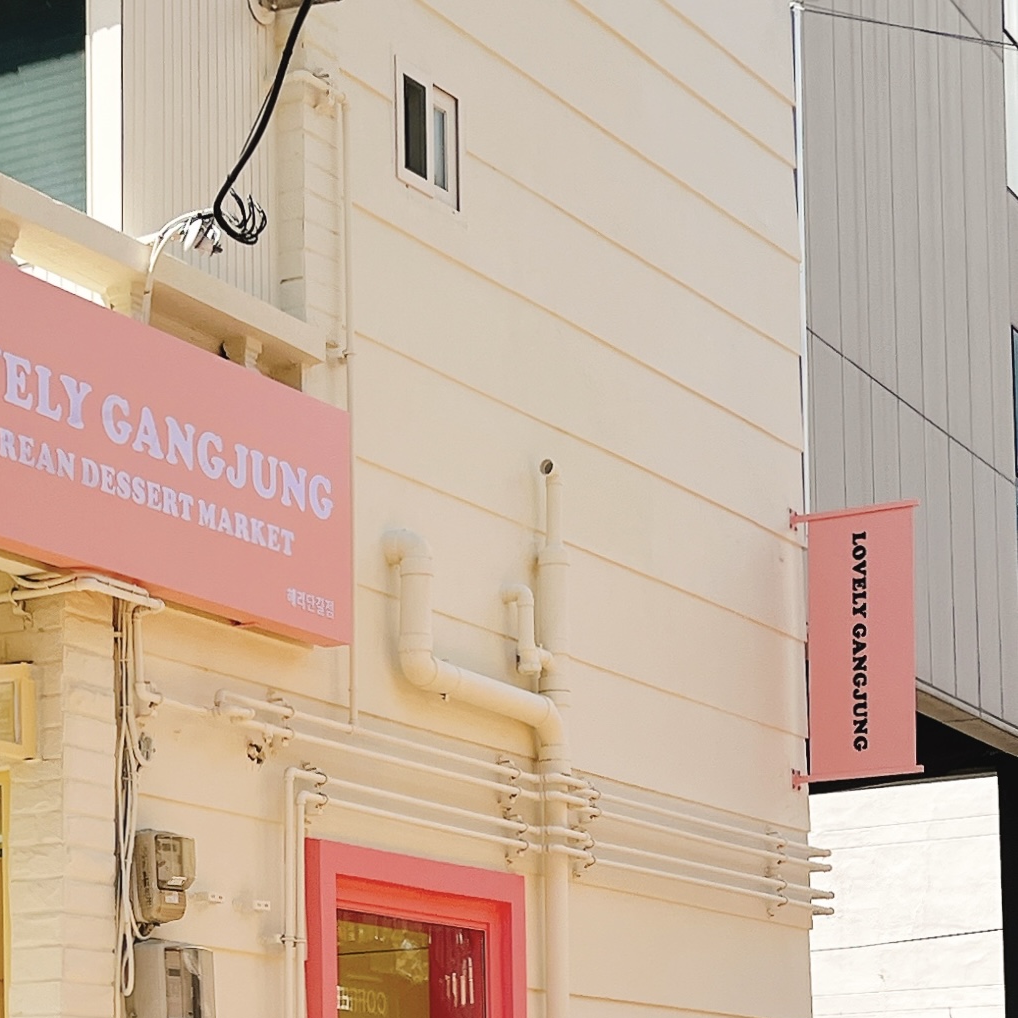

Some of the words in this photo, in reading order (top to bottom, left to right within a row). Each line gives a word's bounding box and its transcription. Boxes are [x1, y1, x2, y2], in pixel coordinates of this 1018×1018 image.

[80, 457, 194, 522] DESSERT
[198, 499, 296, 557] MARKET
[101, 394, 334, 520] GANGJUNG
[851, 531, 867, 619] LOVELY
[851, 623, 868, 752] GANGJUNG
